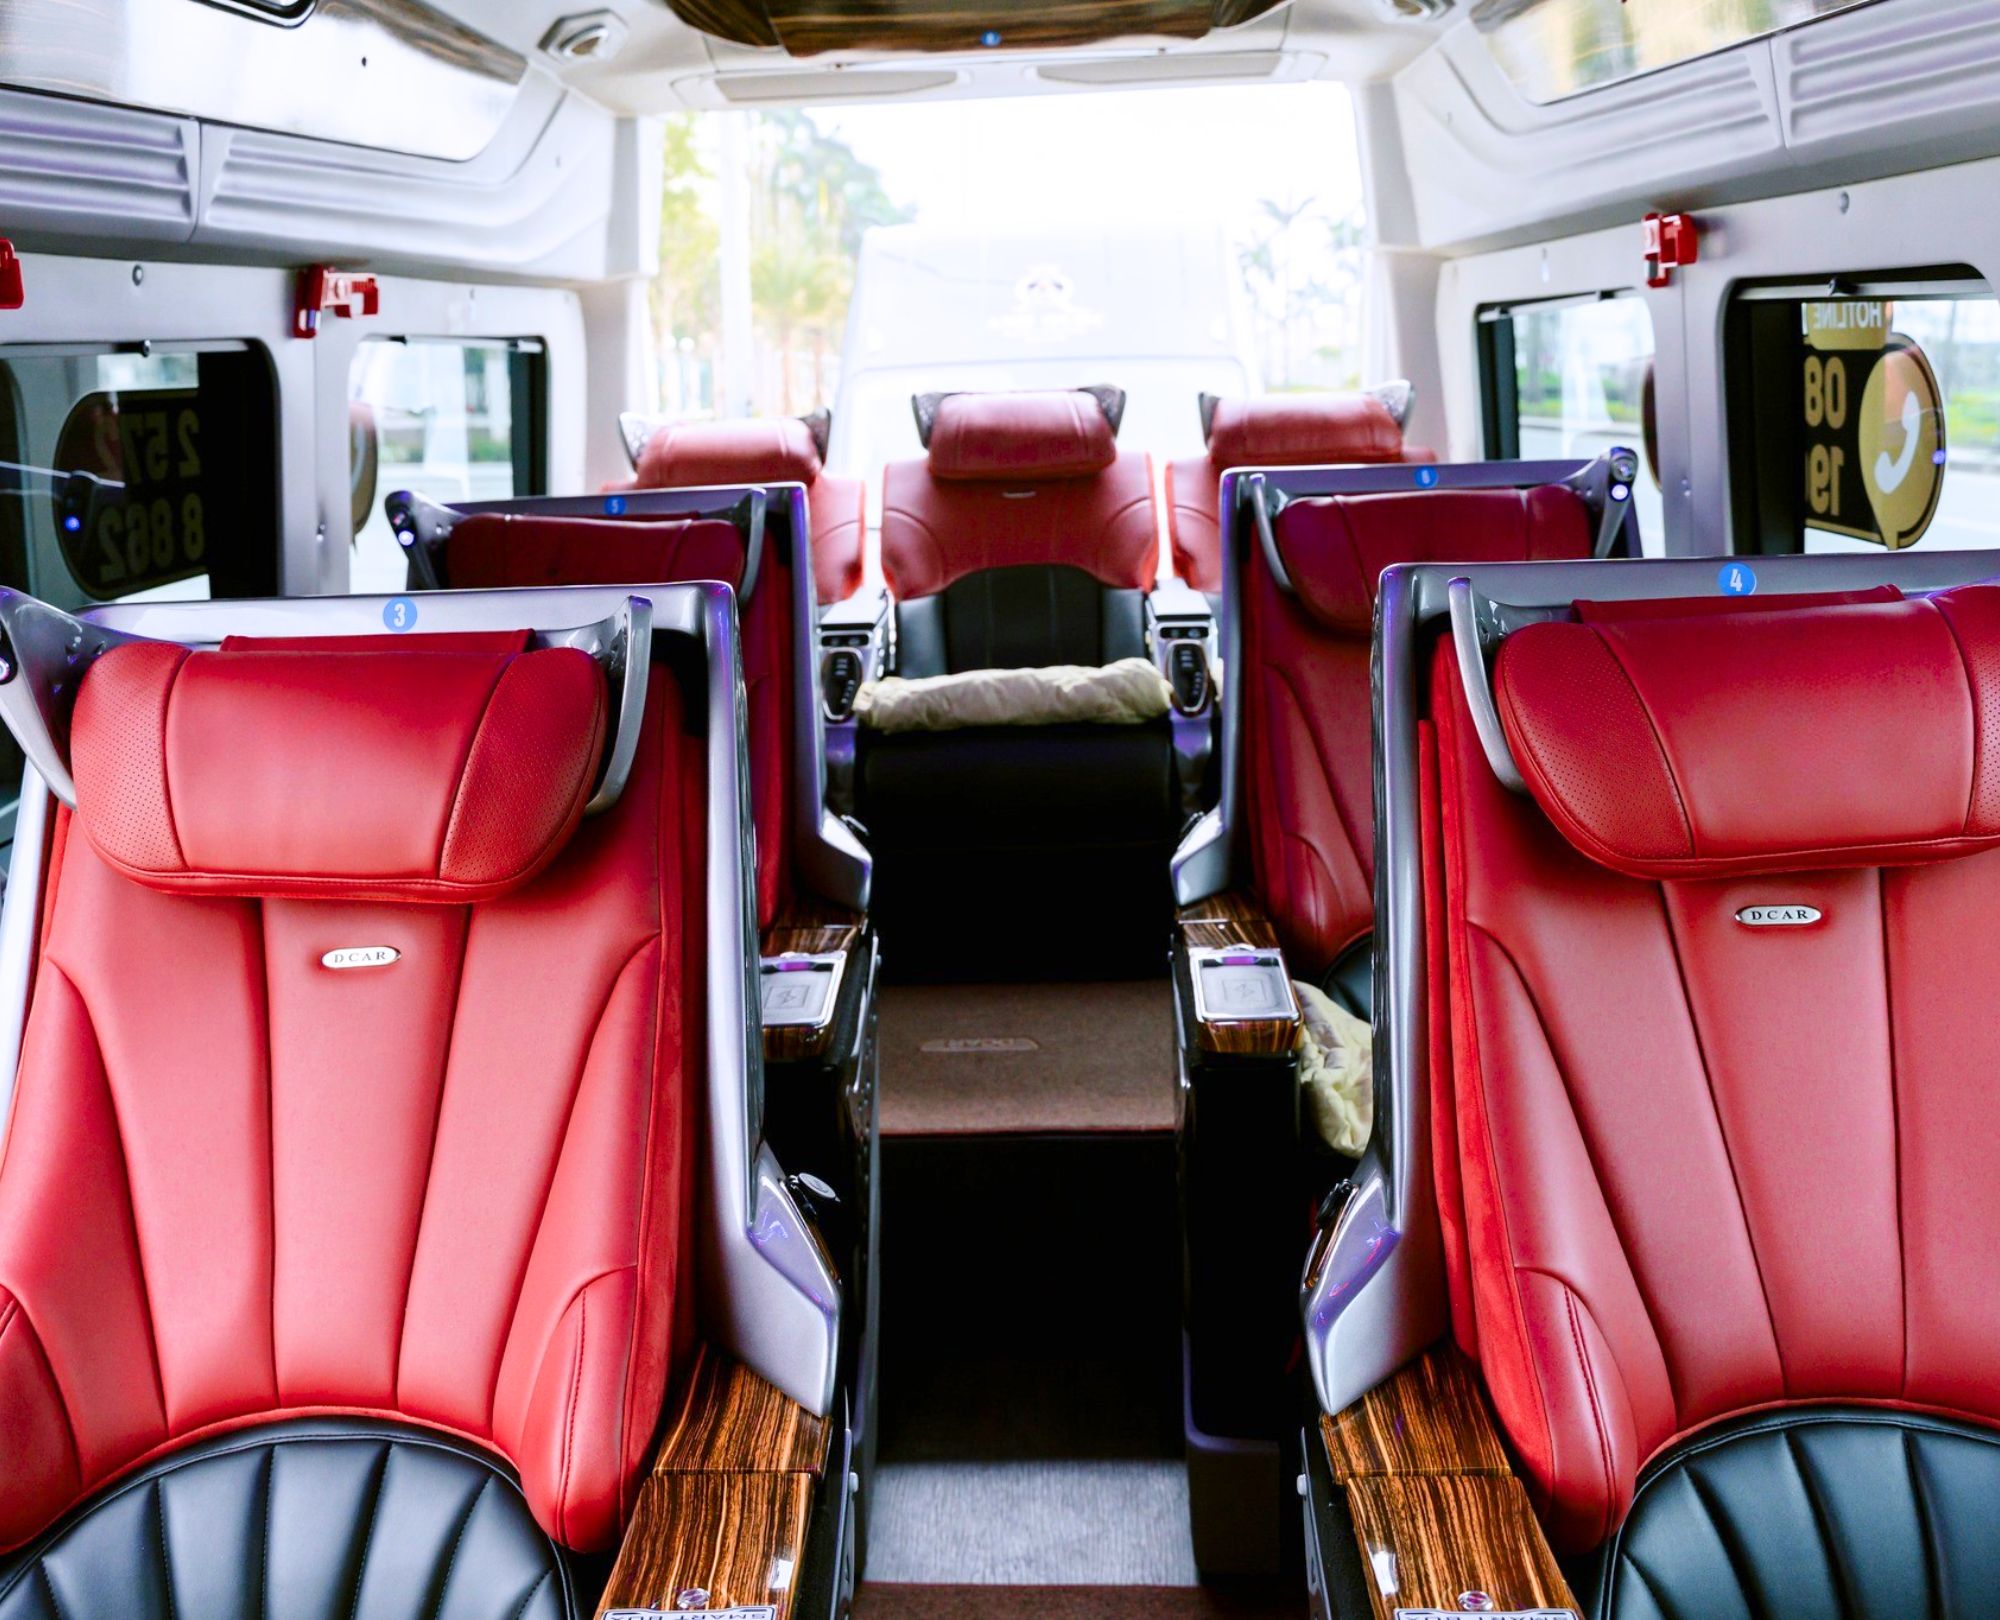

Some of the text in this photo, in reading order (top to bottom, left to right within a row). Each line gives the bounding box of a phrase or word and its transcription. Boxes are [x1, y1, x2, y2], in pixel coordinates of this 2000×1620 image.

[1730, 568, 1743, 592] 4
[393, 603, 406, 627] 3
[1750, 909, 1809, 921] DCAR
[334, 951, 386, 963] DCAR
